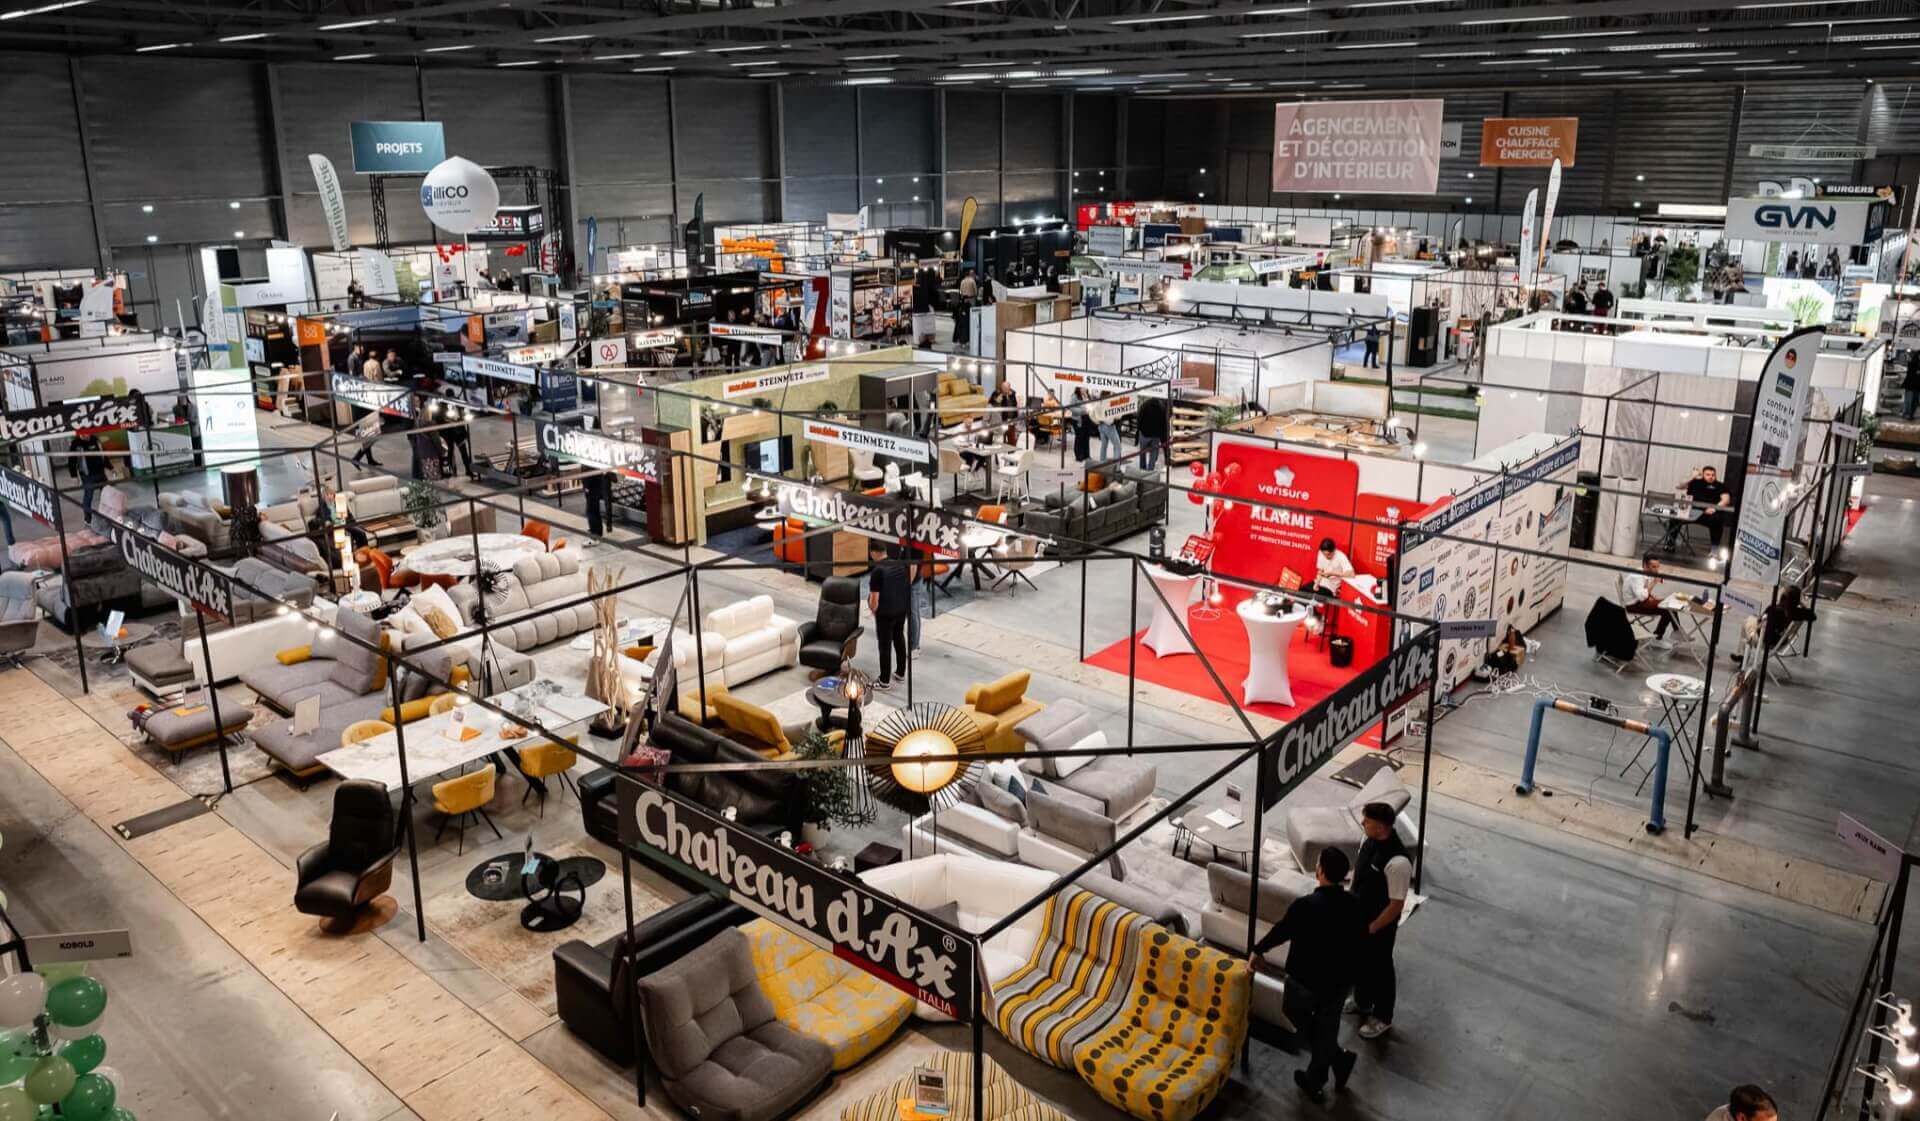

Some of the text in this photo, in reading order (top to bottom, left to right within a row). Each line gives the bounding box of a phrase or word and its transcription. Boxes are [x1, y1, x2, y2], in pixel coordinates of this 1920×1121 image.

[1289, 115, 1424, 136] AGENCEMENT
[1508, 126, 1551, 137] CUISINE
[376, 142, 423, 155] PROJETS
[1279, 136, 1434, 158] ET DÉCORATION
[1496, 137, 1561, 148] CHAUFFAGE
[1500, 147, 1553, 159] ÉNERGIES
[1294, 158, 1415, 180] D'INTÉRIEUR
[1826, 185, 1874, 193] BURGERS
[1754, 205, 1837, 229] GVN
[759, 371, 804, 387] STEINMETZ
[1086, 375, 1137, 389] STEINMETZ
[0, 412, 66, 440] teau
[842, 431, 896, 450] STEINMETZ
[1258, 483, 1310, 500] verisure
[790, 486, 891, 534] Chateau
[122, 530, 229, 615] Chateau d'Ax
[1277, 646, 1434, 784] Chateau d'Ax
[635, 790, 957, 998] Chateau d'Ax
[918, 987, 953, 1013] ITALIA
